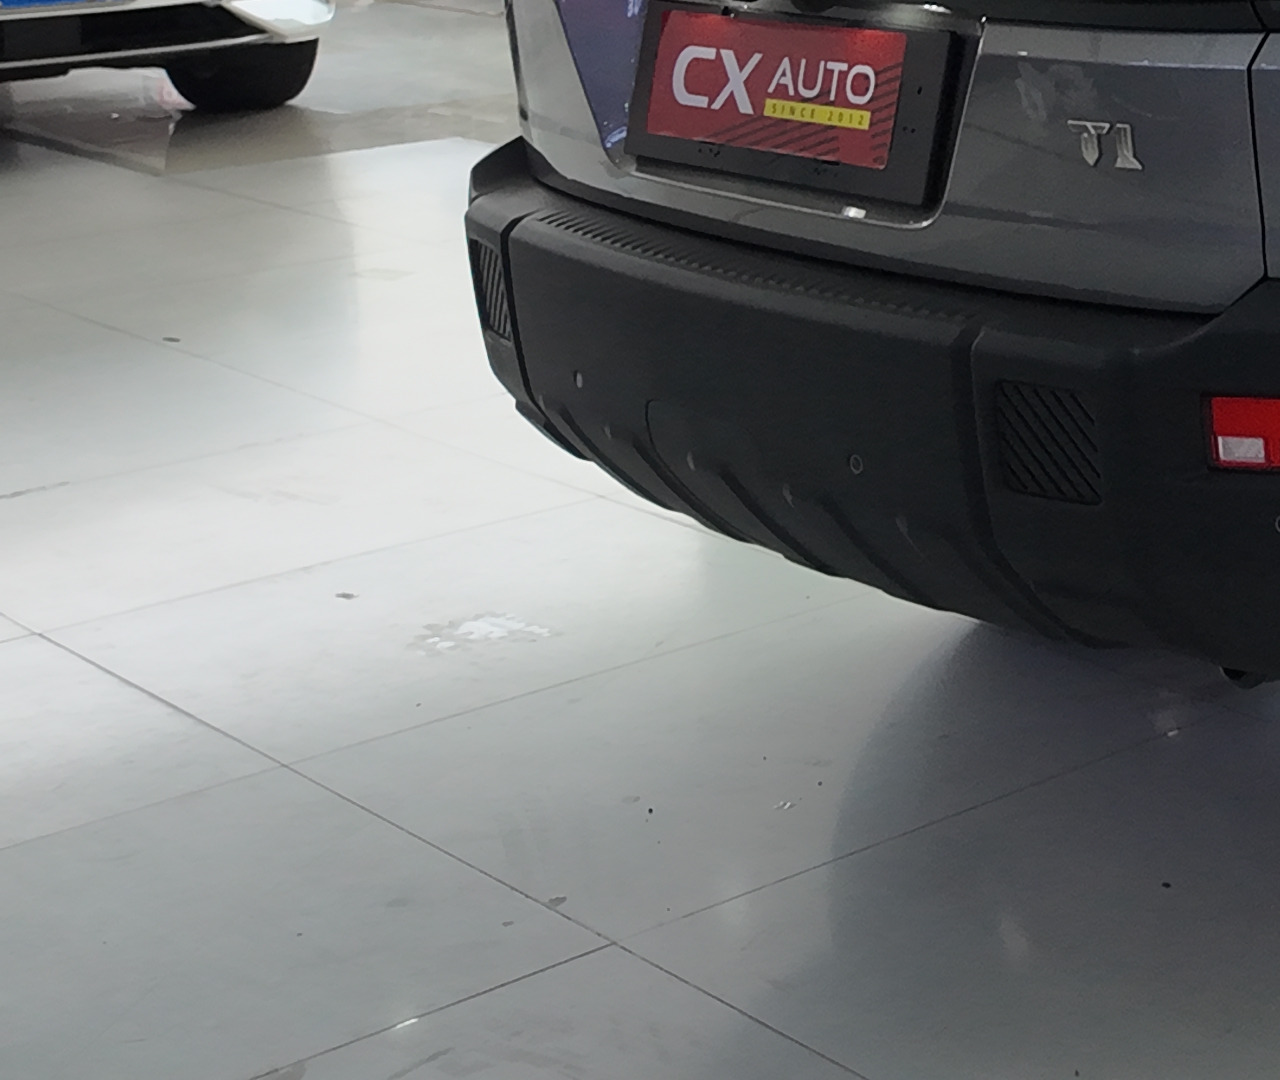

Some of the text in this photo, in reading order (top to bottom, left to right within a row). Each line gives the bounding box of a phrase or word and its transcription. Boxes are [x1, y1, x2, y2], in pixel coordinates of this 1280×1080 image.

[671, 45, 875, 115] CX AUTO
[771, 103, 864, 126] SINCE 2012
